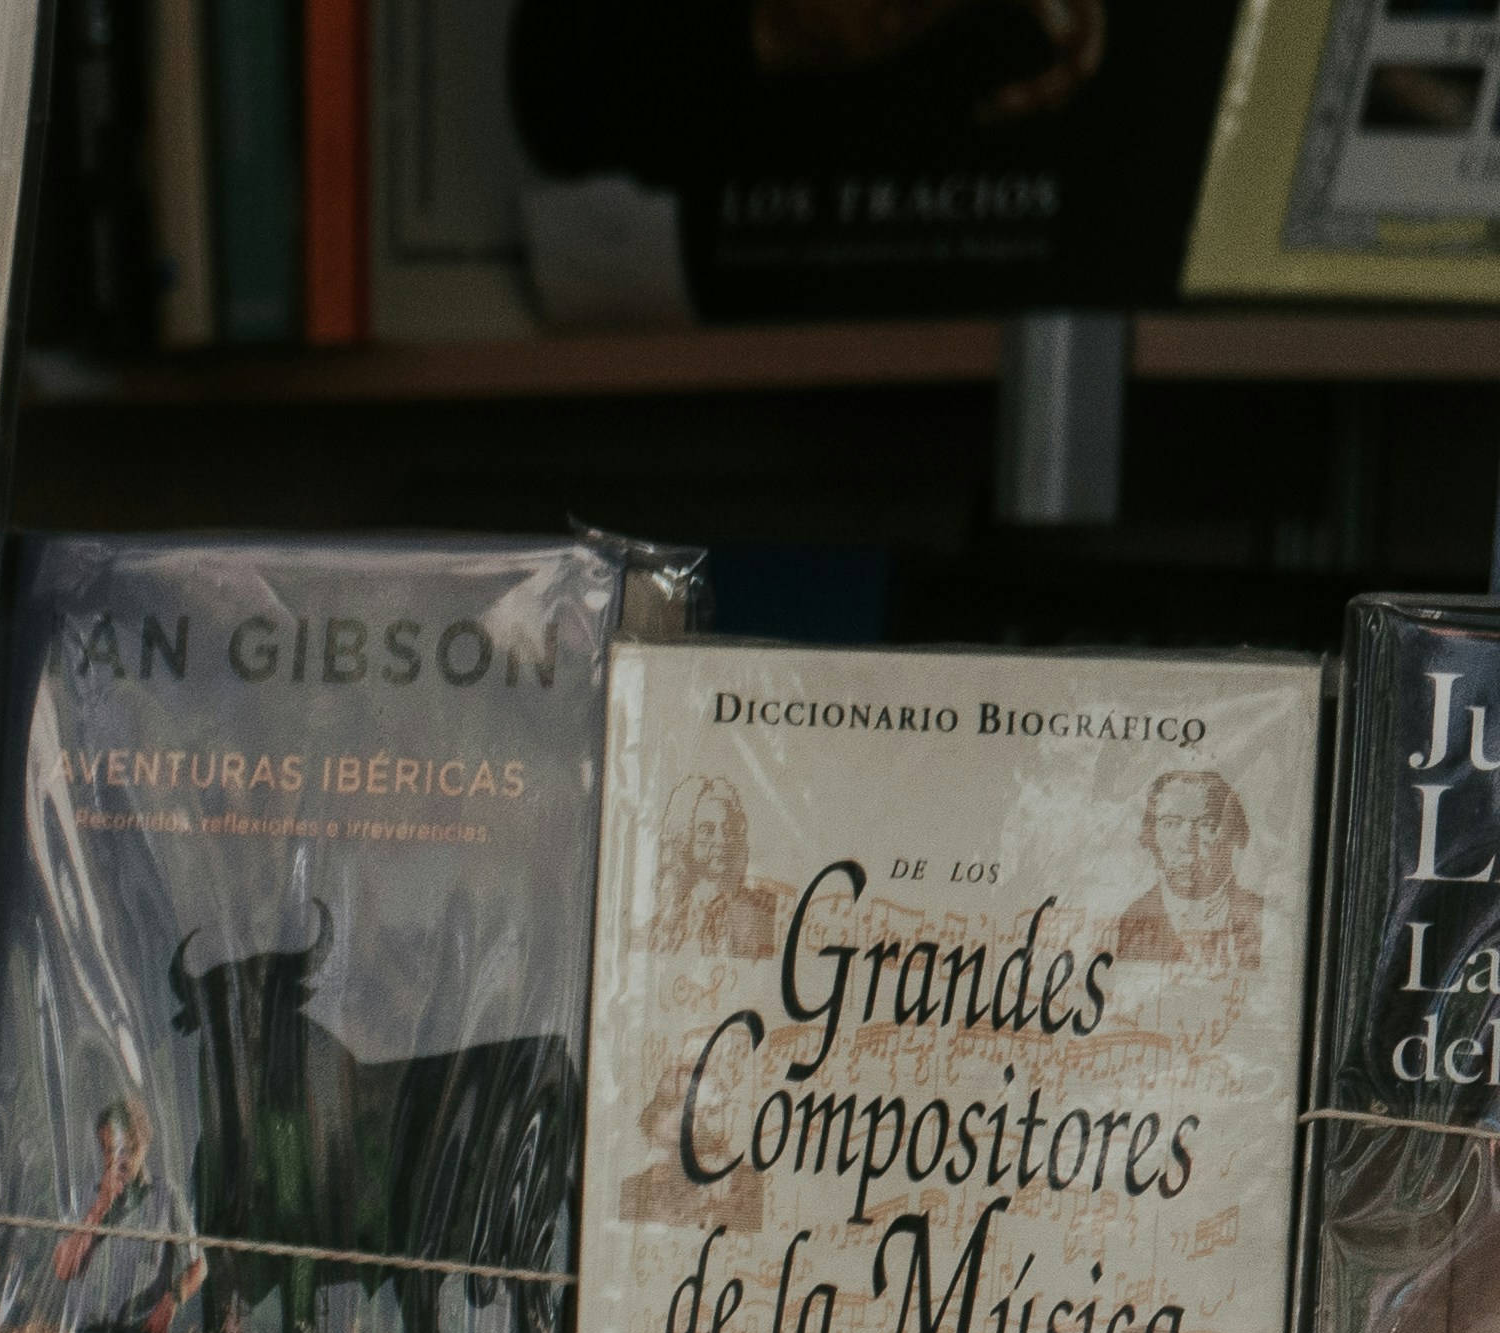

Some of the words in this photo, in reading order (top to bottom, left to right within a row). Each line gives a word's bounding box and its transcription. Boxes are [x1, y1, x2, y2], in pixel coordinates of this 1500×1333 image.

[228, 615, 558, 689] GIBSON
[57, 747, 303, 792] AVENTURAS
[321, 747, 526, 798] IBÉRICAS
[890, 857, 927, 883] DE
[950, 858, 1002, 886] LOS
[779, 859, 1115, 1082] Grandes
[679, 1009, 1203, 1226] Compositores
